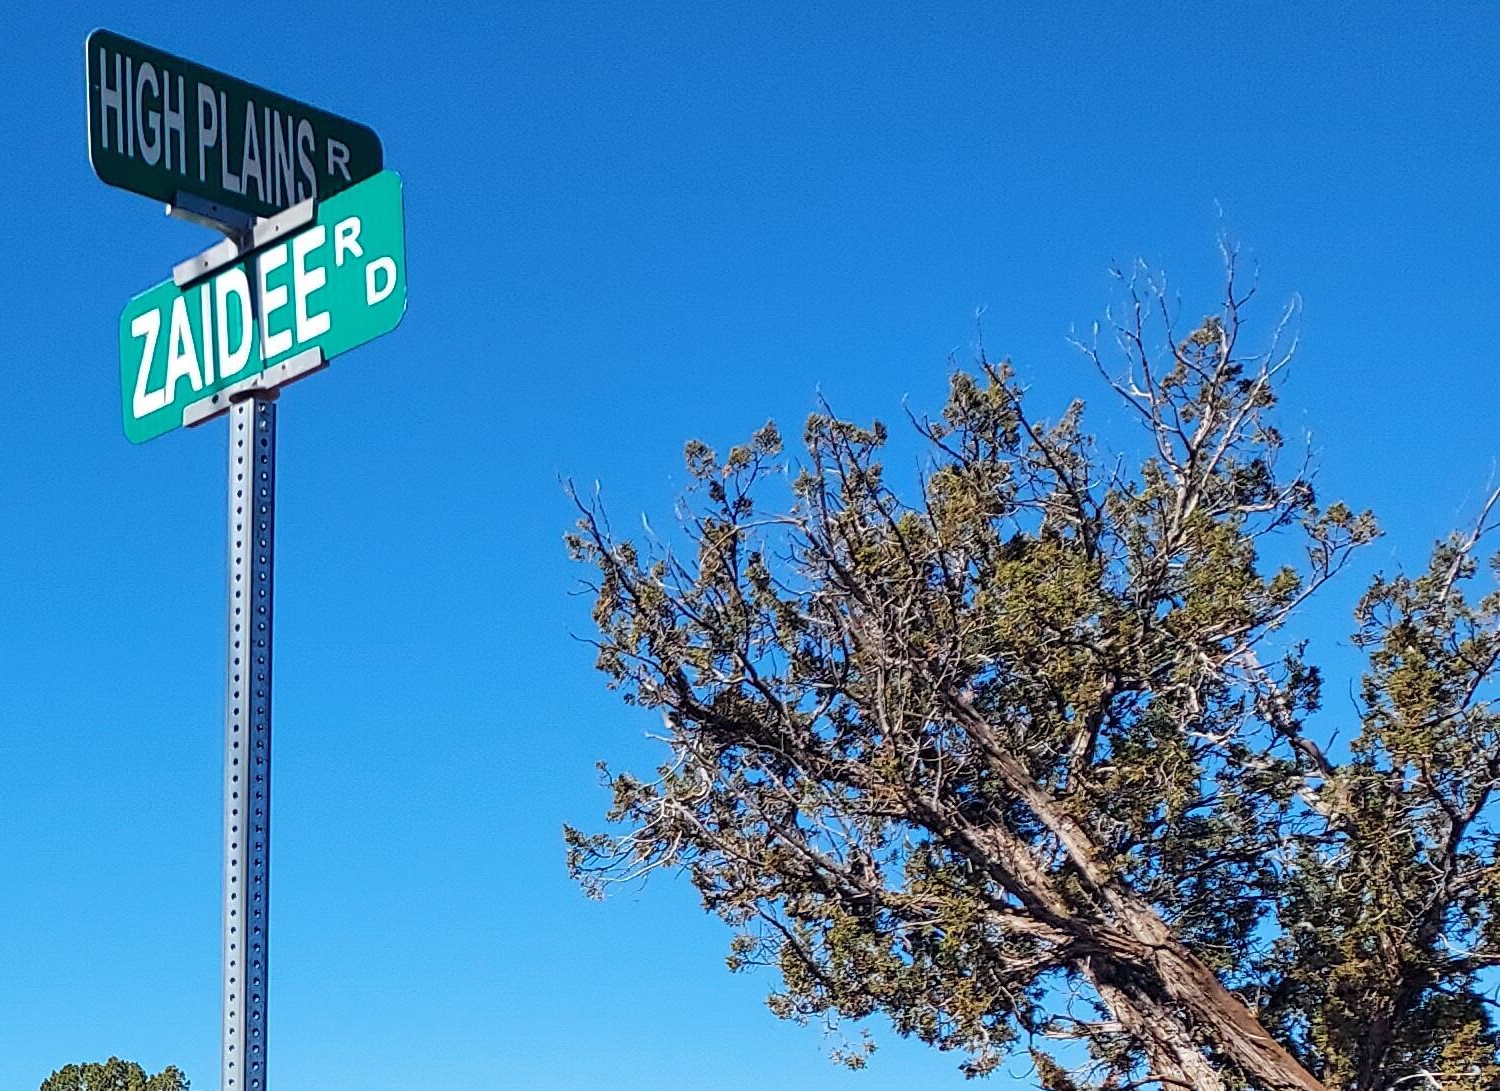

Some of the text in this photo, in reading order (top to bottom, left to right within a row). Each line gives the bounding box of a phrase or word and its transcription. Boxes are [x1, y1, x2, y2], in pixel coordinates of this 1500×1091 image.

[99, 46, 187, 176] HIGH
[198, 82, 318, 208] PLAINS
[131, 225, 331, 420] ZAIDEE
